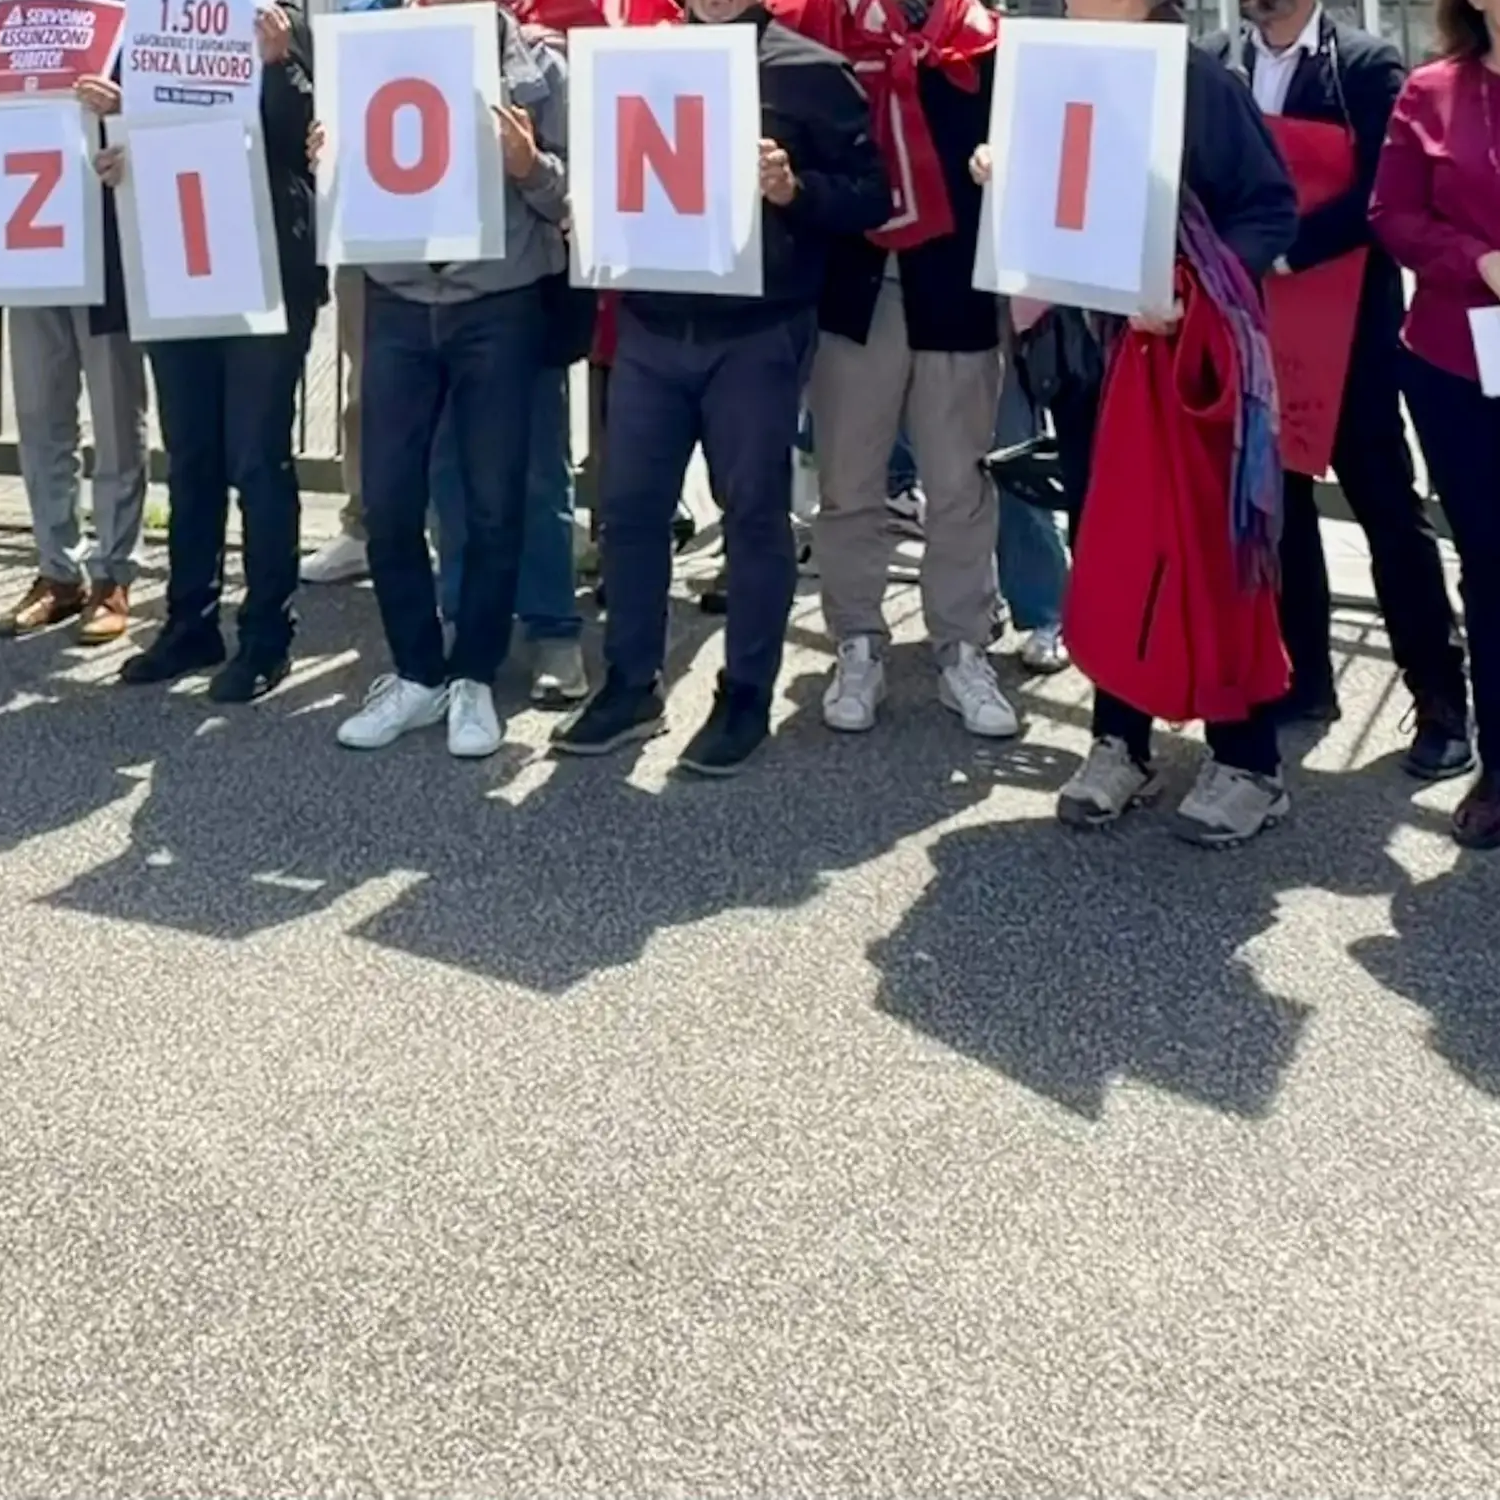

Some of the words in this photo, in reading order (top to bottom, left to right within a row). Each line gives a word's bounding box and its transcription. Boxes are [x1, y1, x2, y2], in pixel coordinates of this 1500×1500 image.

[131, 48, 181, 75] SENZA
[187, 54, 253, 79] LAVORO
[4, 150, 64, 250] Z
[176, 171, 211, 277] I
[365, 77, 450, 195] O
[615, 95, 706, 215] N
[1055, 102, 1093, 231] I
